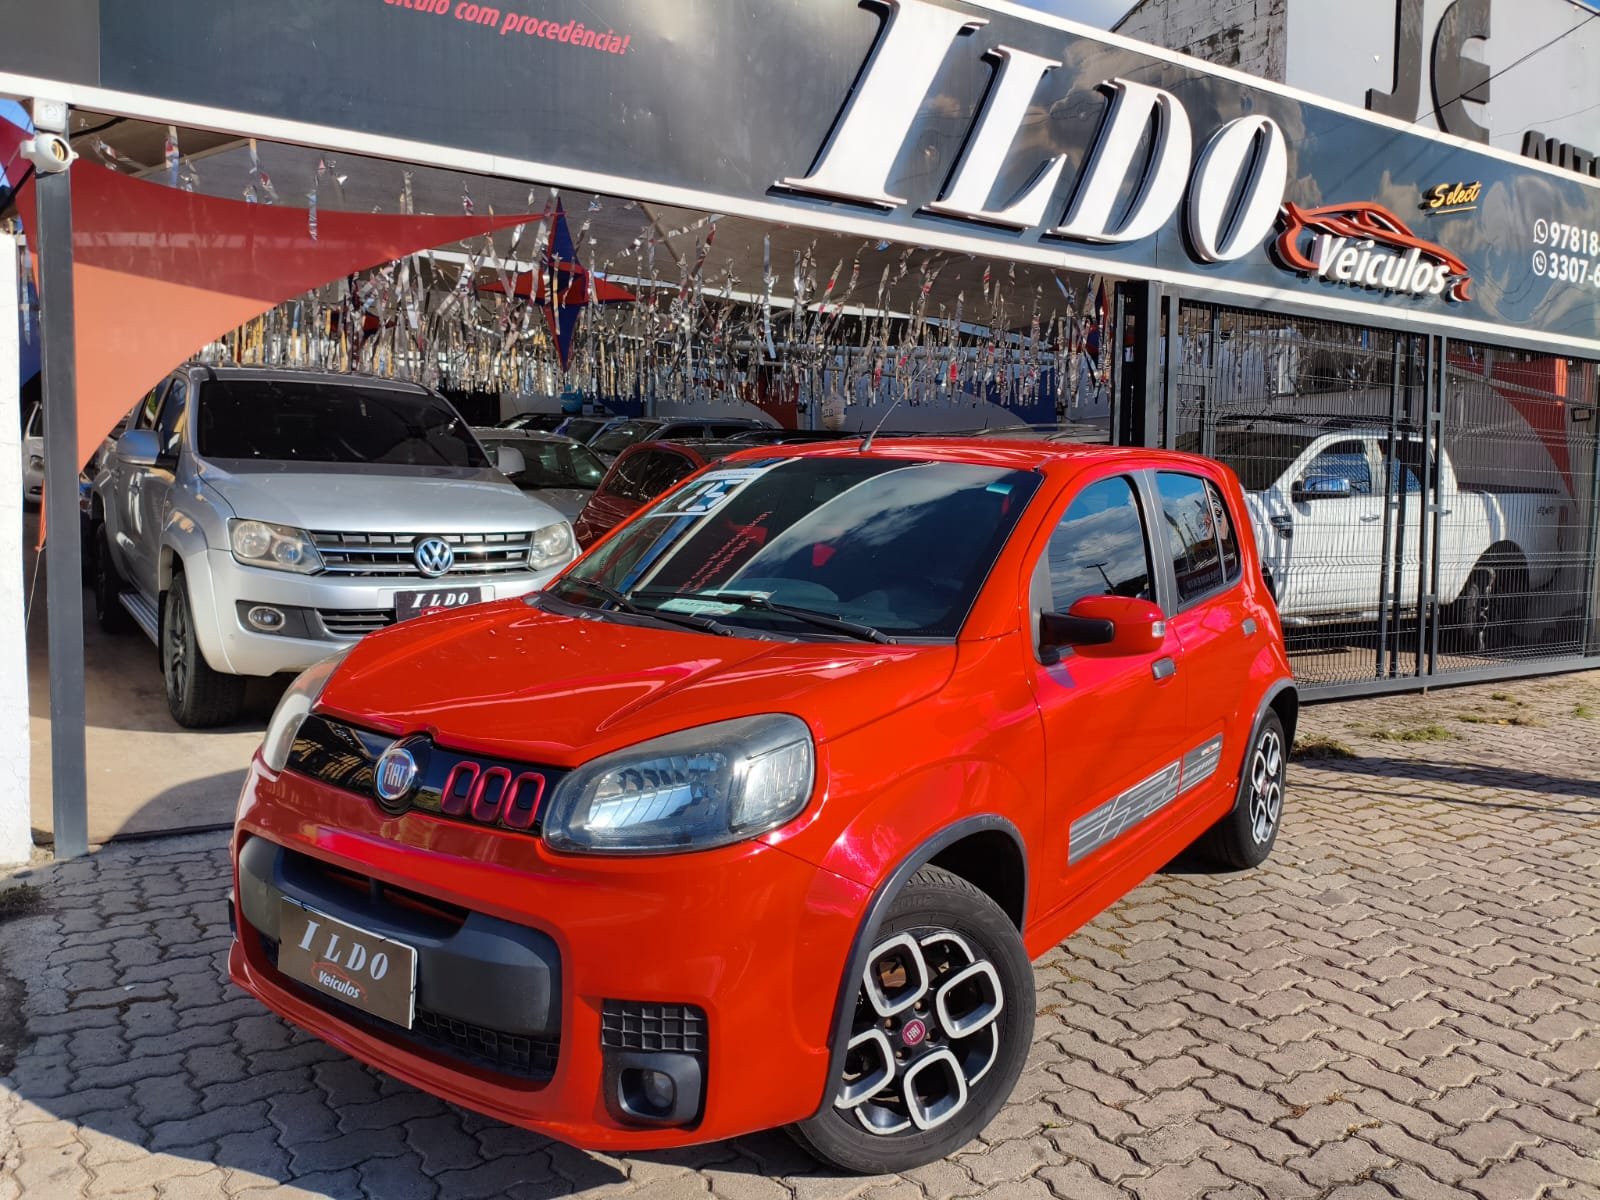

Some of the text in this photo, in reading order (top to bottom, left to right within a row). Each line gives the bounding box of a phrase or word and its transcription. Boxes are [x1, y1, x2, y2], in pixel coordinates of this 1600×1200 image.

[454, 1, 499, 27] com
[500, 13, 631, 55] procedência!
[782, 0, 1288, 262] ILDO
[1430, 180, 1482, 208] Select
[410, 592, 469, 608] ILDO
[383, 761, 408, 788] FIAT
[298, 919, 389, 980] ILDO
